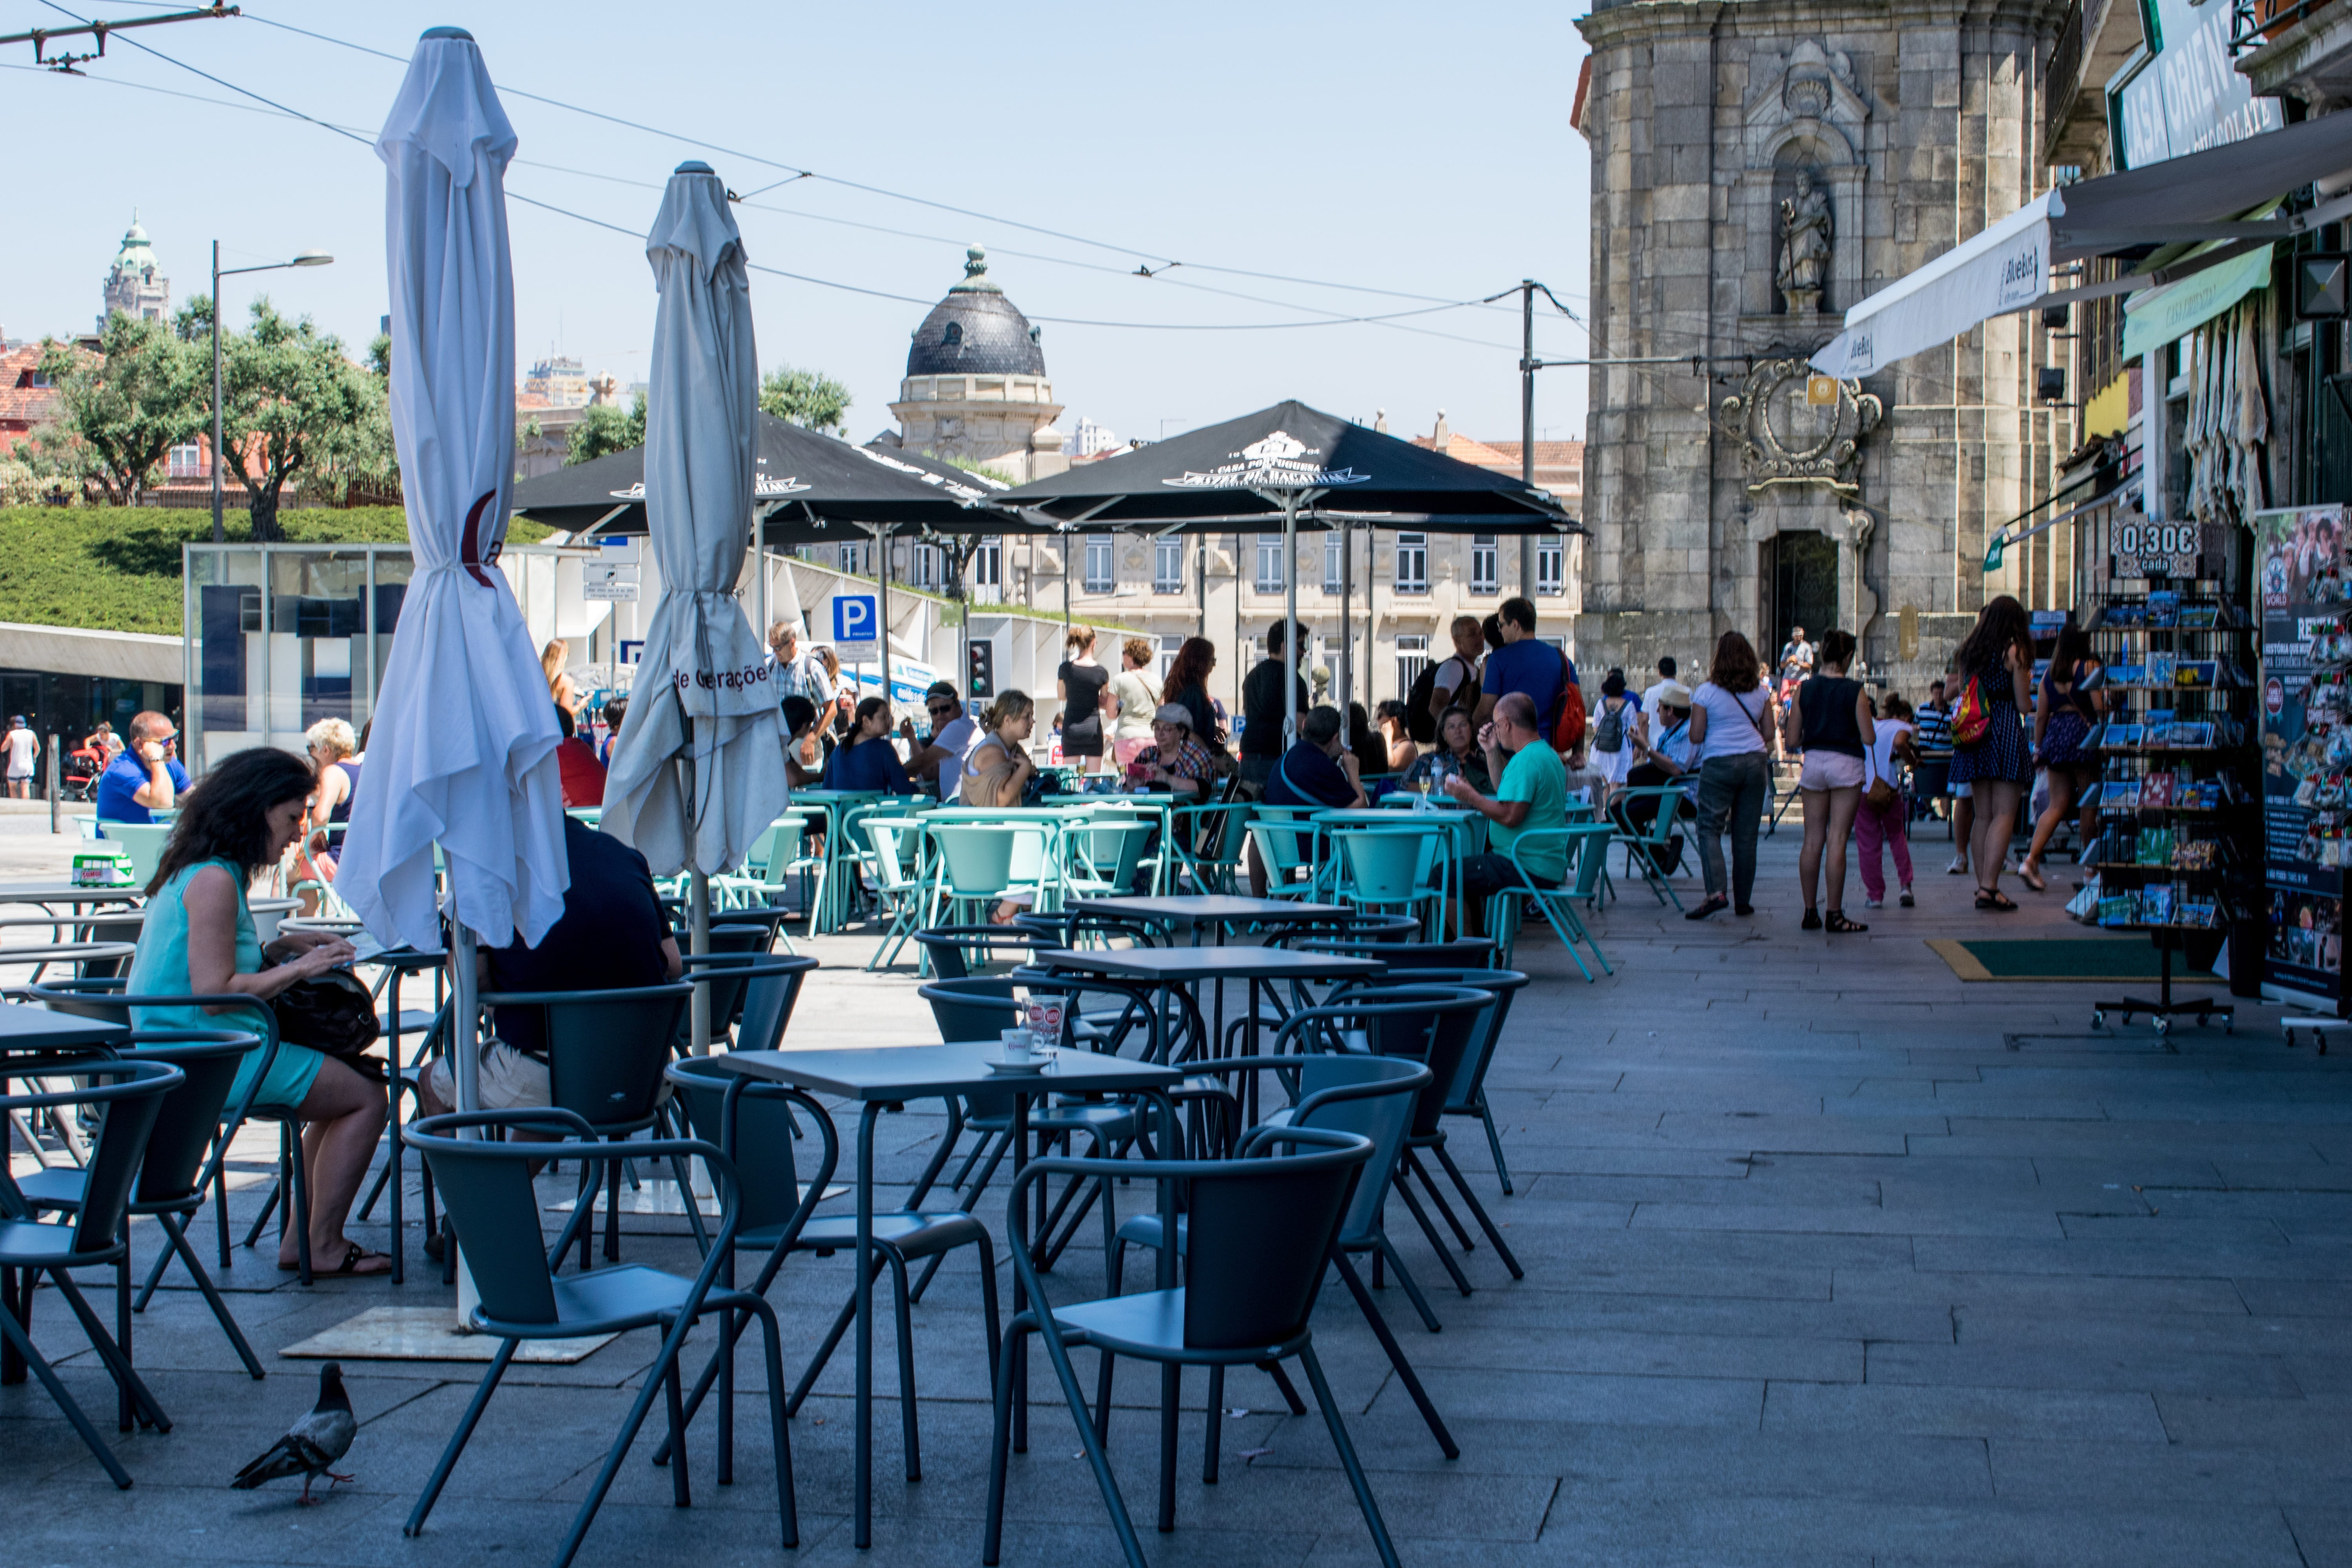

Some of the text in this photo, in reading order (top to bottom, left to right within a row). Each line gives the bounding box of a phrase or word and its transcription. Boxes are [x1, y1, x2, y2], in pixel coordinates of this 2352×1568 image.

[2165, 1, 2242, 136] ORIENT
[2005, 252, 2033, 285] BlueBus
[1218, 458, 1320, 474] CASA PORTUGUESA
[2122, 526, 2193, 558] 0,30€
[2141, 557, 2170, 571] cada
[2266, 593, 2287, 606] WORLD
[843, 600, 867, 638] P
[2265, 640, 2288, 654] HISTÓRIA
[2289, 643, 2299, 657] QUE
[673, 665, 767, 693] de Geraçõe
